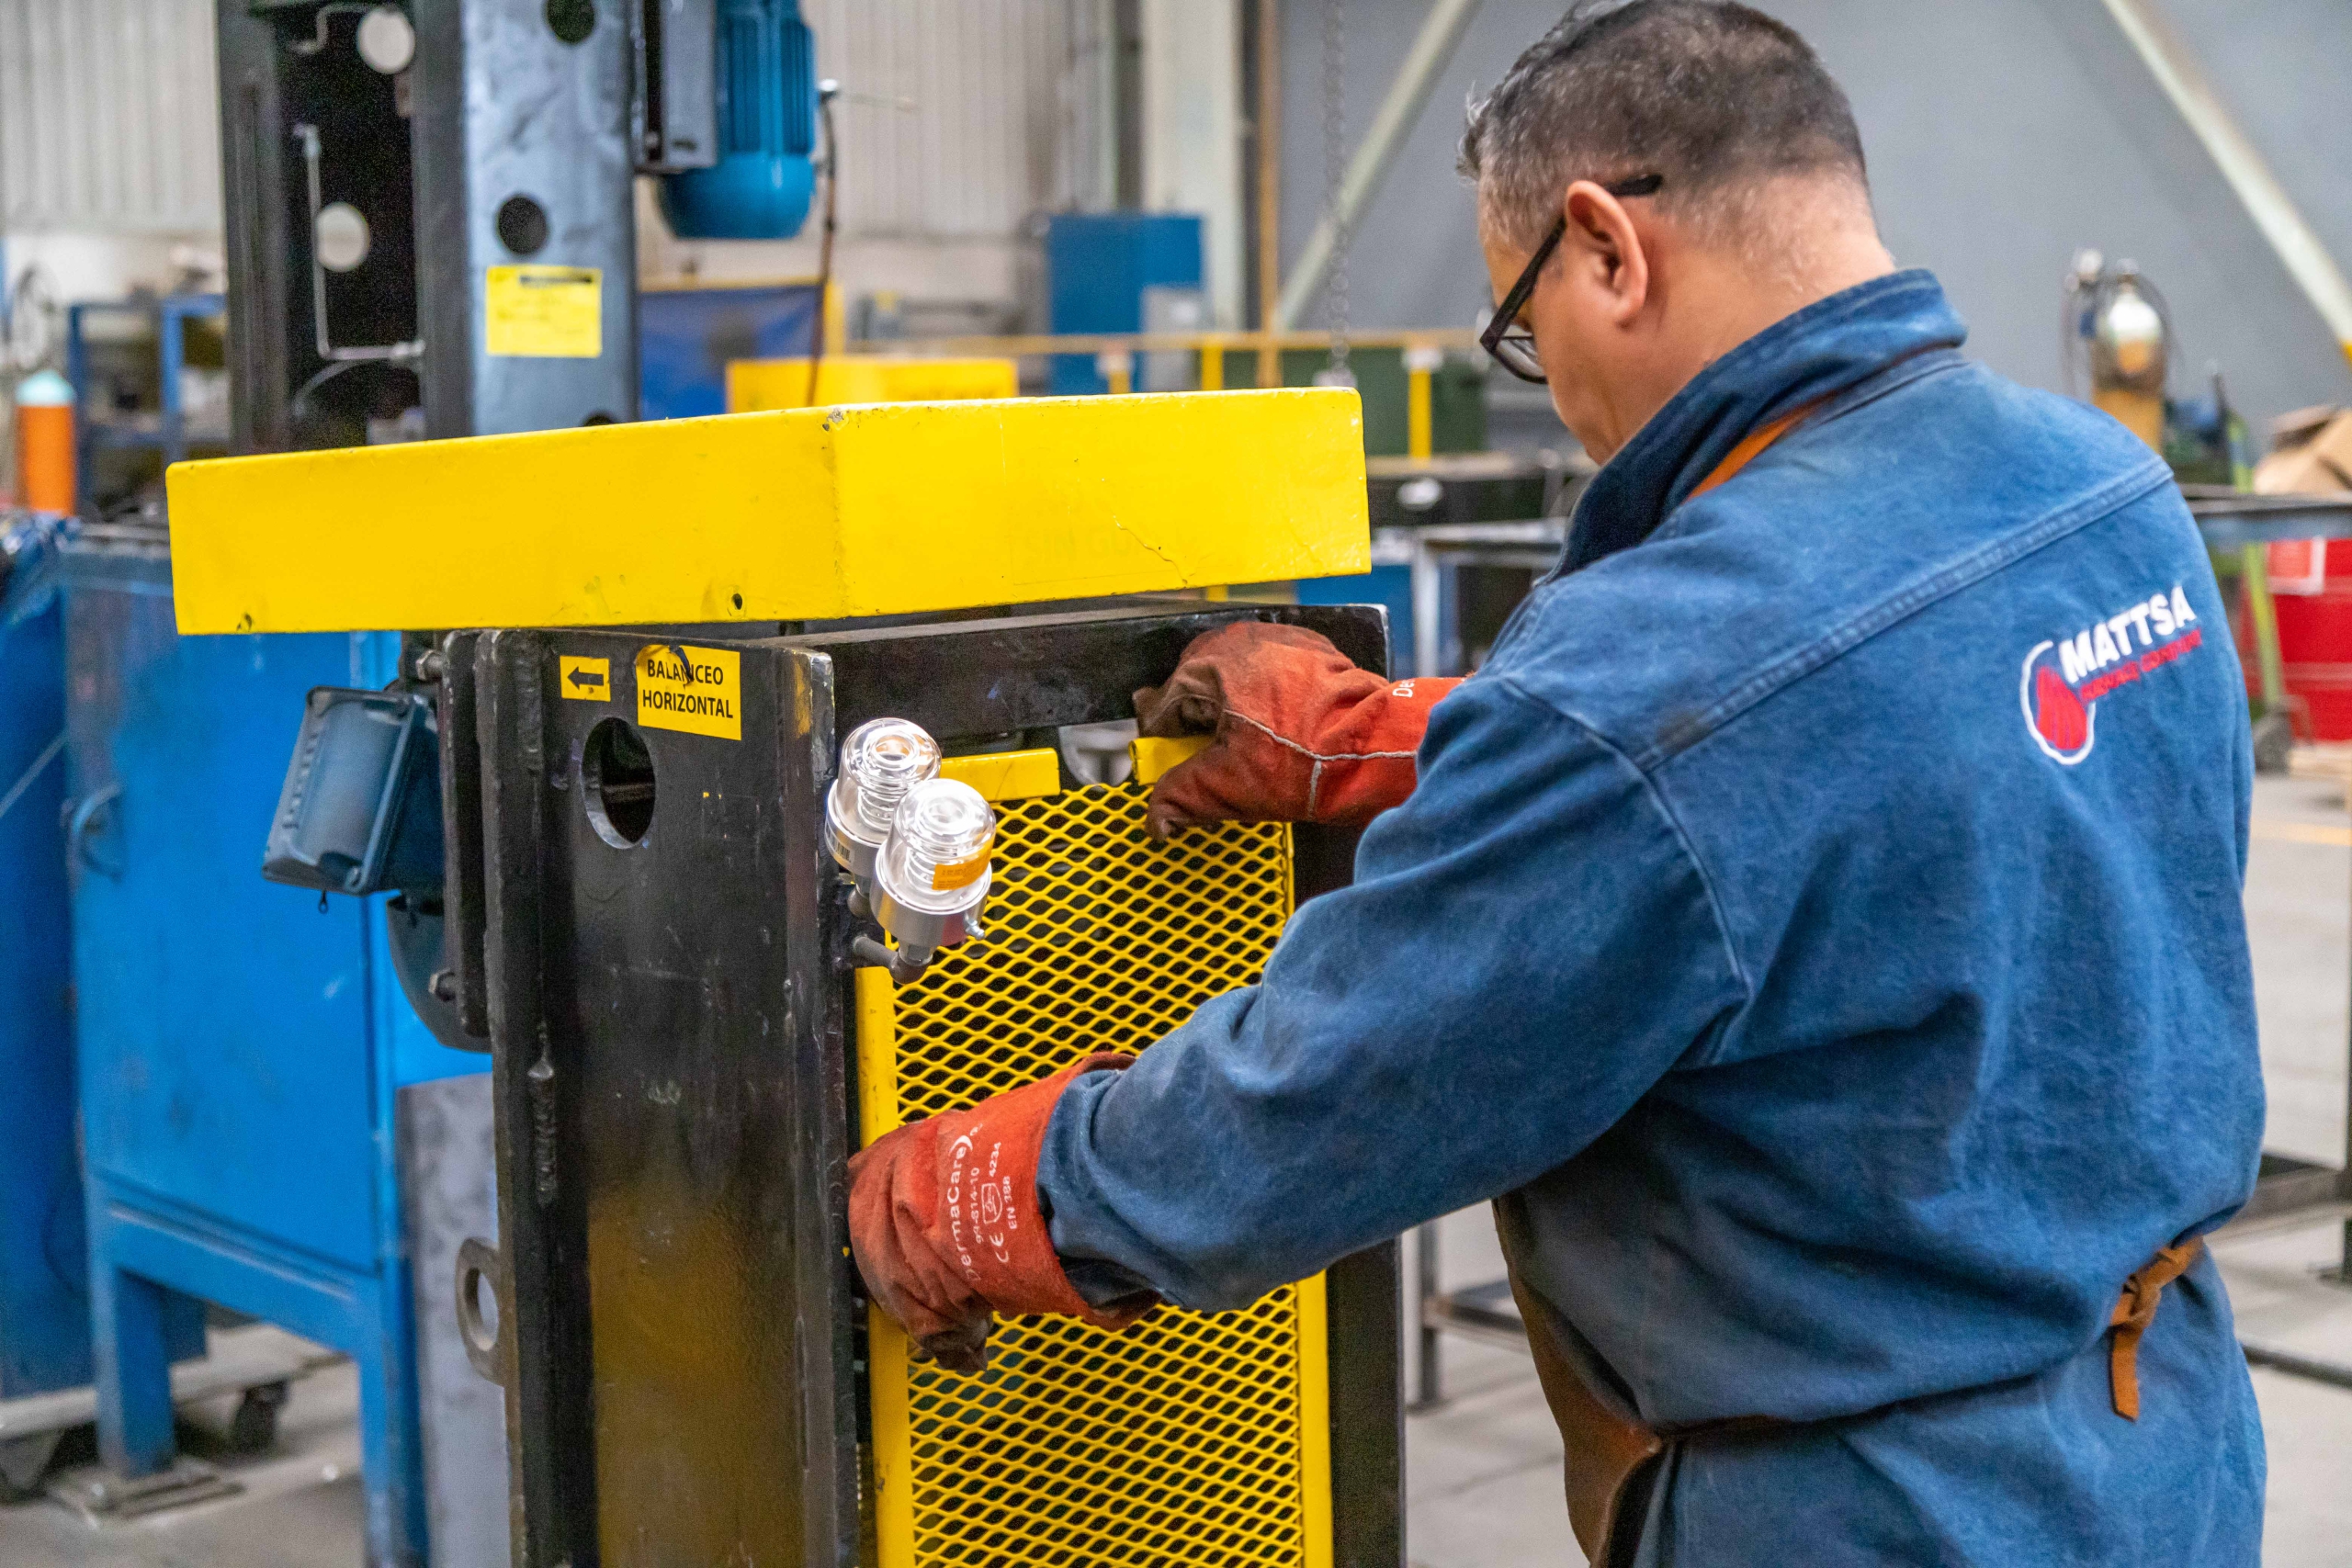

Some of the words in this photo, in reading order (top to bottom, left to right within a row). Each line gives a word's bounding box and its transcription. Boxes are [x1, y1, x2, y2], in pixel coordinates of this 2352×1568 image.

[2058, 585, 2198, 684] MATTSA
[647, 659, 724, 685] BALANCEO
[642, 689, 734, 719] HORIZONTAL
[1006, 1206, 1018, 1230] EN
